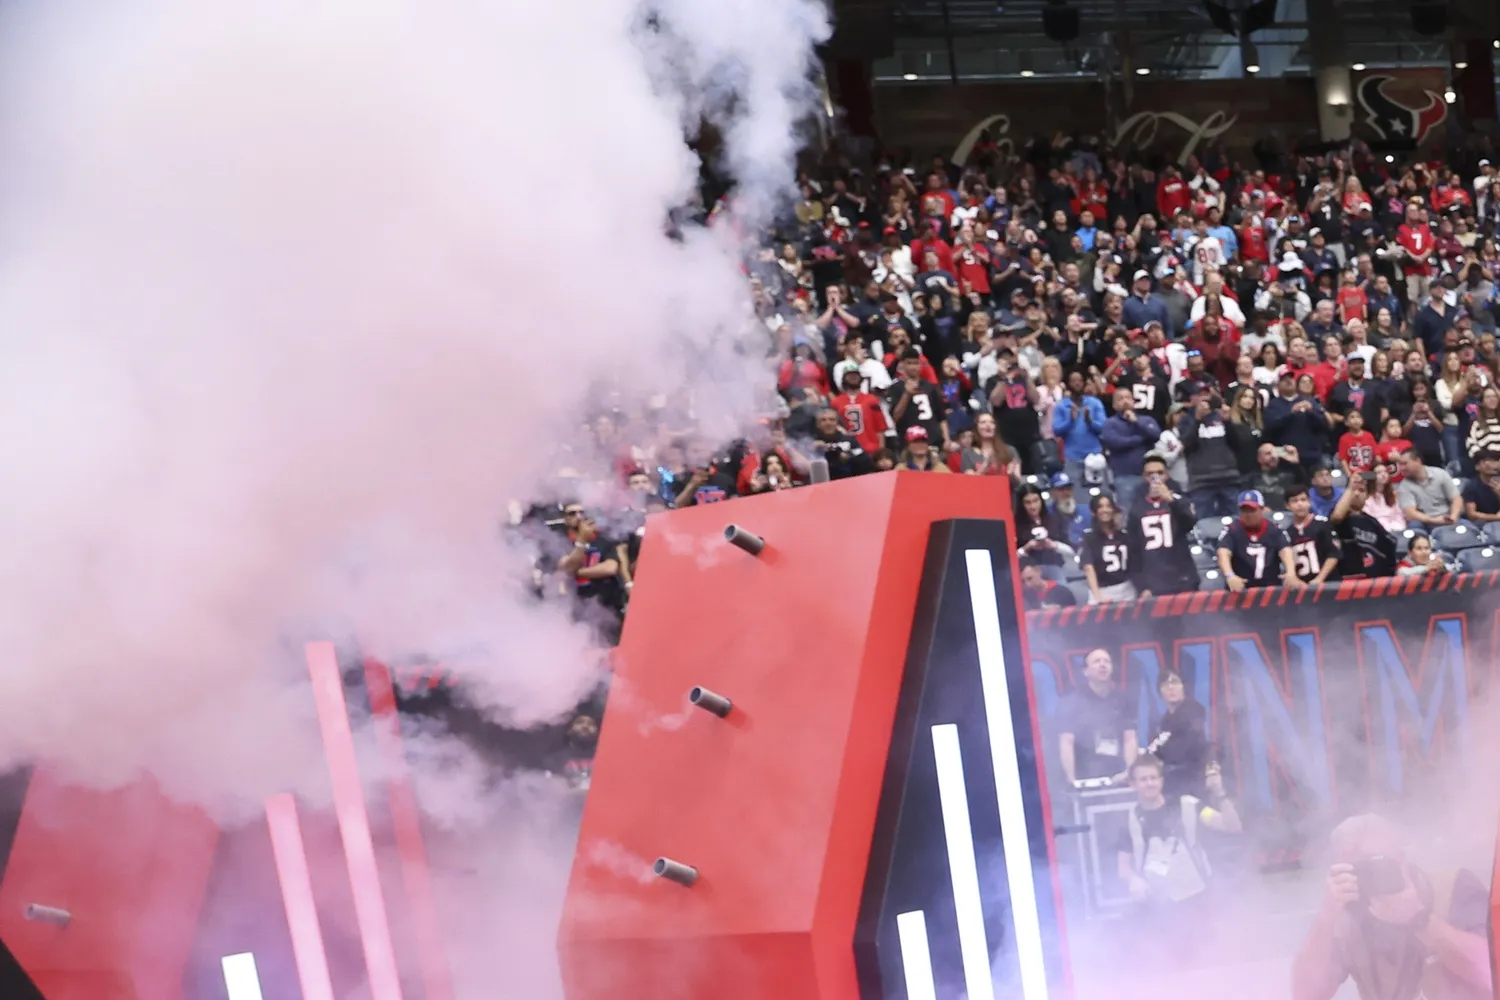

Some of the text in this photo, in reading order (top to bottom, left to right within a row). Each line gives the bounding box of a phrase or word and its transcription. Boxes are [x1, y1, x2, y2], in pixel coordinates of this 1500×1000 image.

[1411, 232, 1423, 250] 7
[912, 393, 933, 421] 3
[1132, 383, 1156, 411] 51
[845, 403, 865, 436] 3
[1141, 513, 1173, 550] 51
[1102, 544, 1128, 573] 51
[1246, 546, 1267, 580] 7
[1291, 540, 1320, 577] 51
